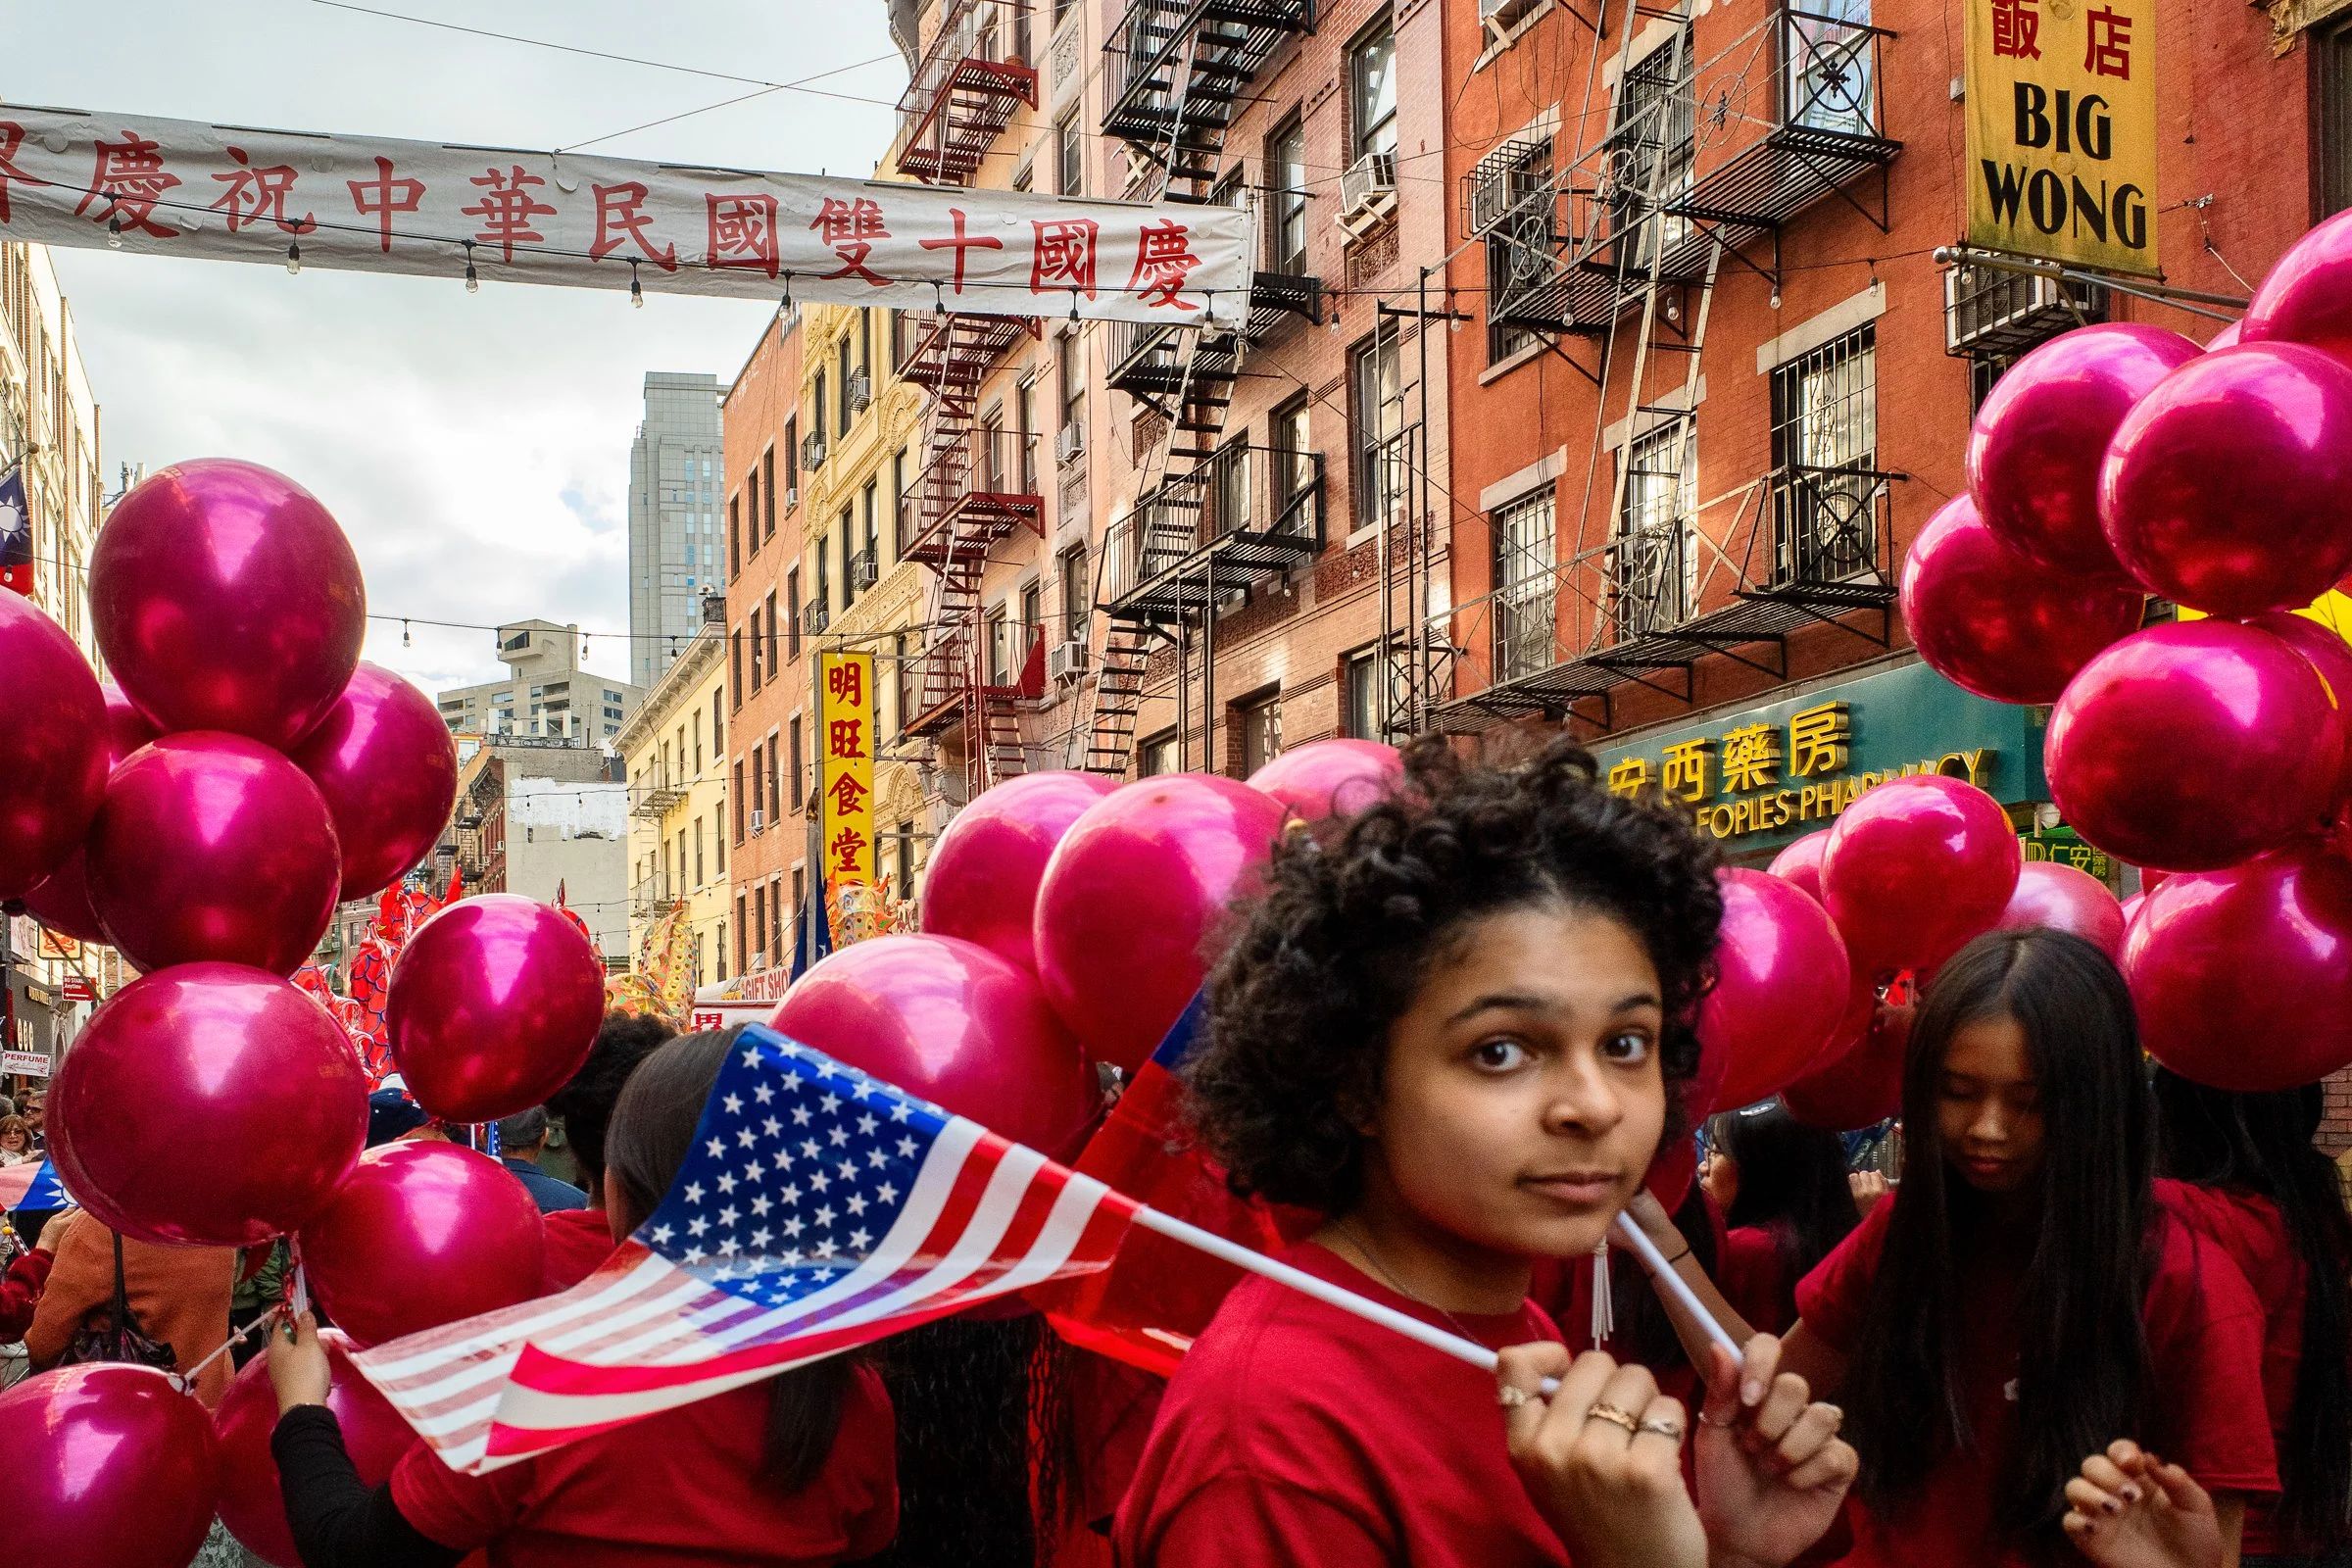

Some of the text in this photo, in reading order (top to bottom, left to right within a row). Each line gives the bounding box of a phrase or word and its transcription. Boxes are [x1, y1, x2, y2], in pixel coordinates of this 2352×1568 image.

[1991, 0, 2132, 80] 飯店
[2014, 80, 2112, 161] BIG
[1981, 159, 2147, 250] WONG
[828, 662, 868, 872] 明旺食堂
[745, 976, 765, 1000] GIFT
[4, 1054, 49, 1064] PERFUME
